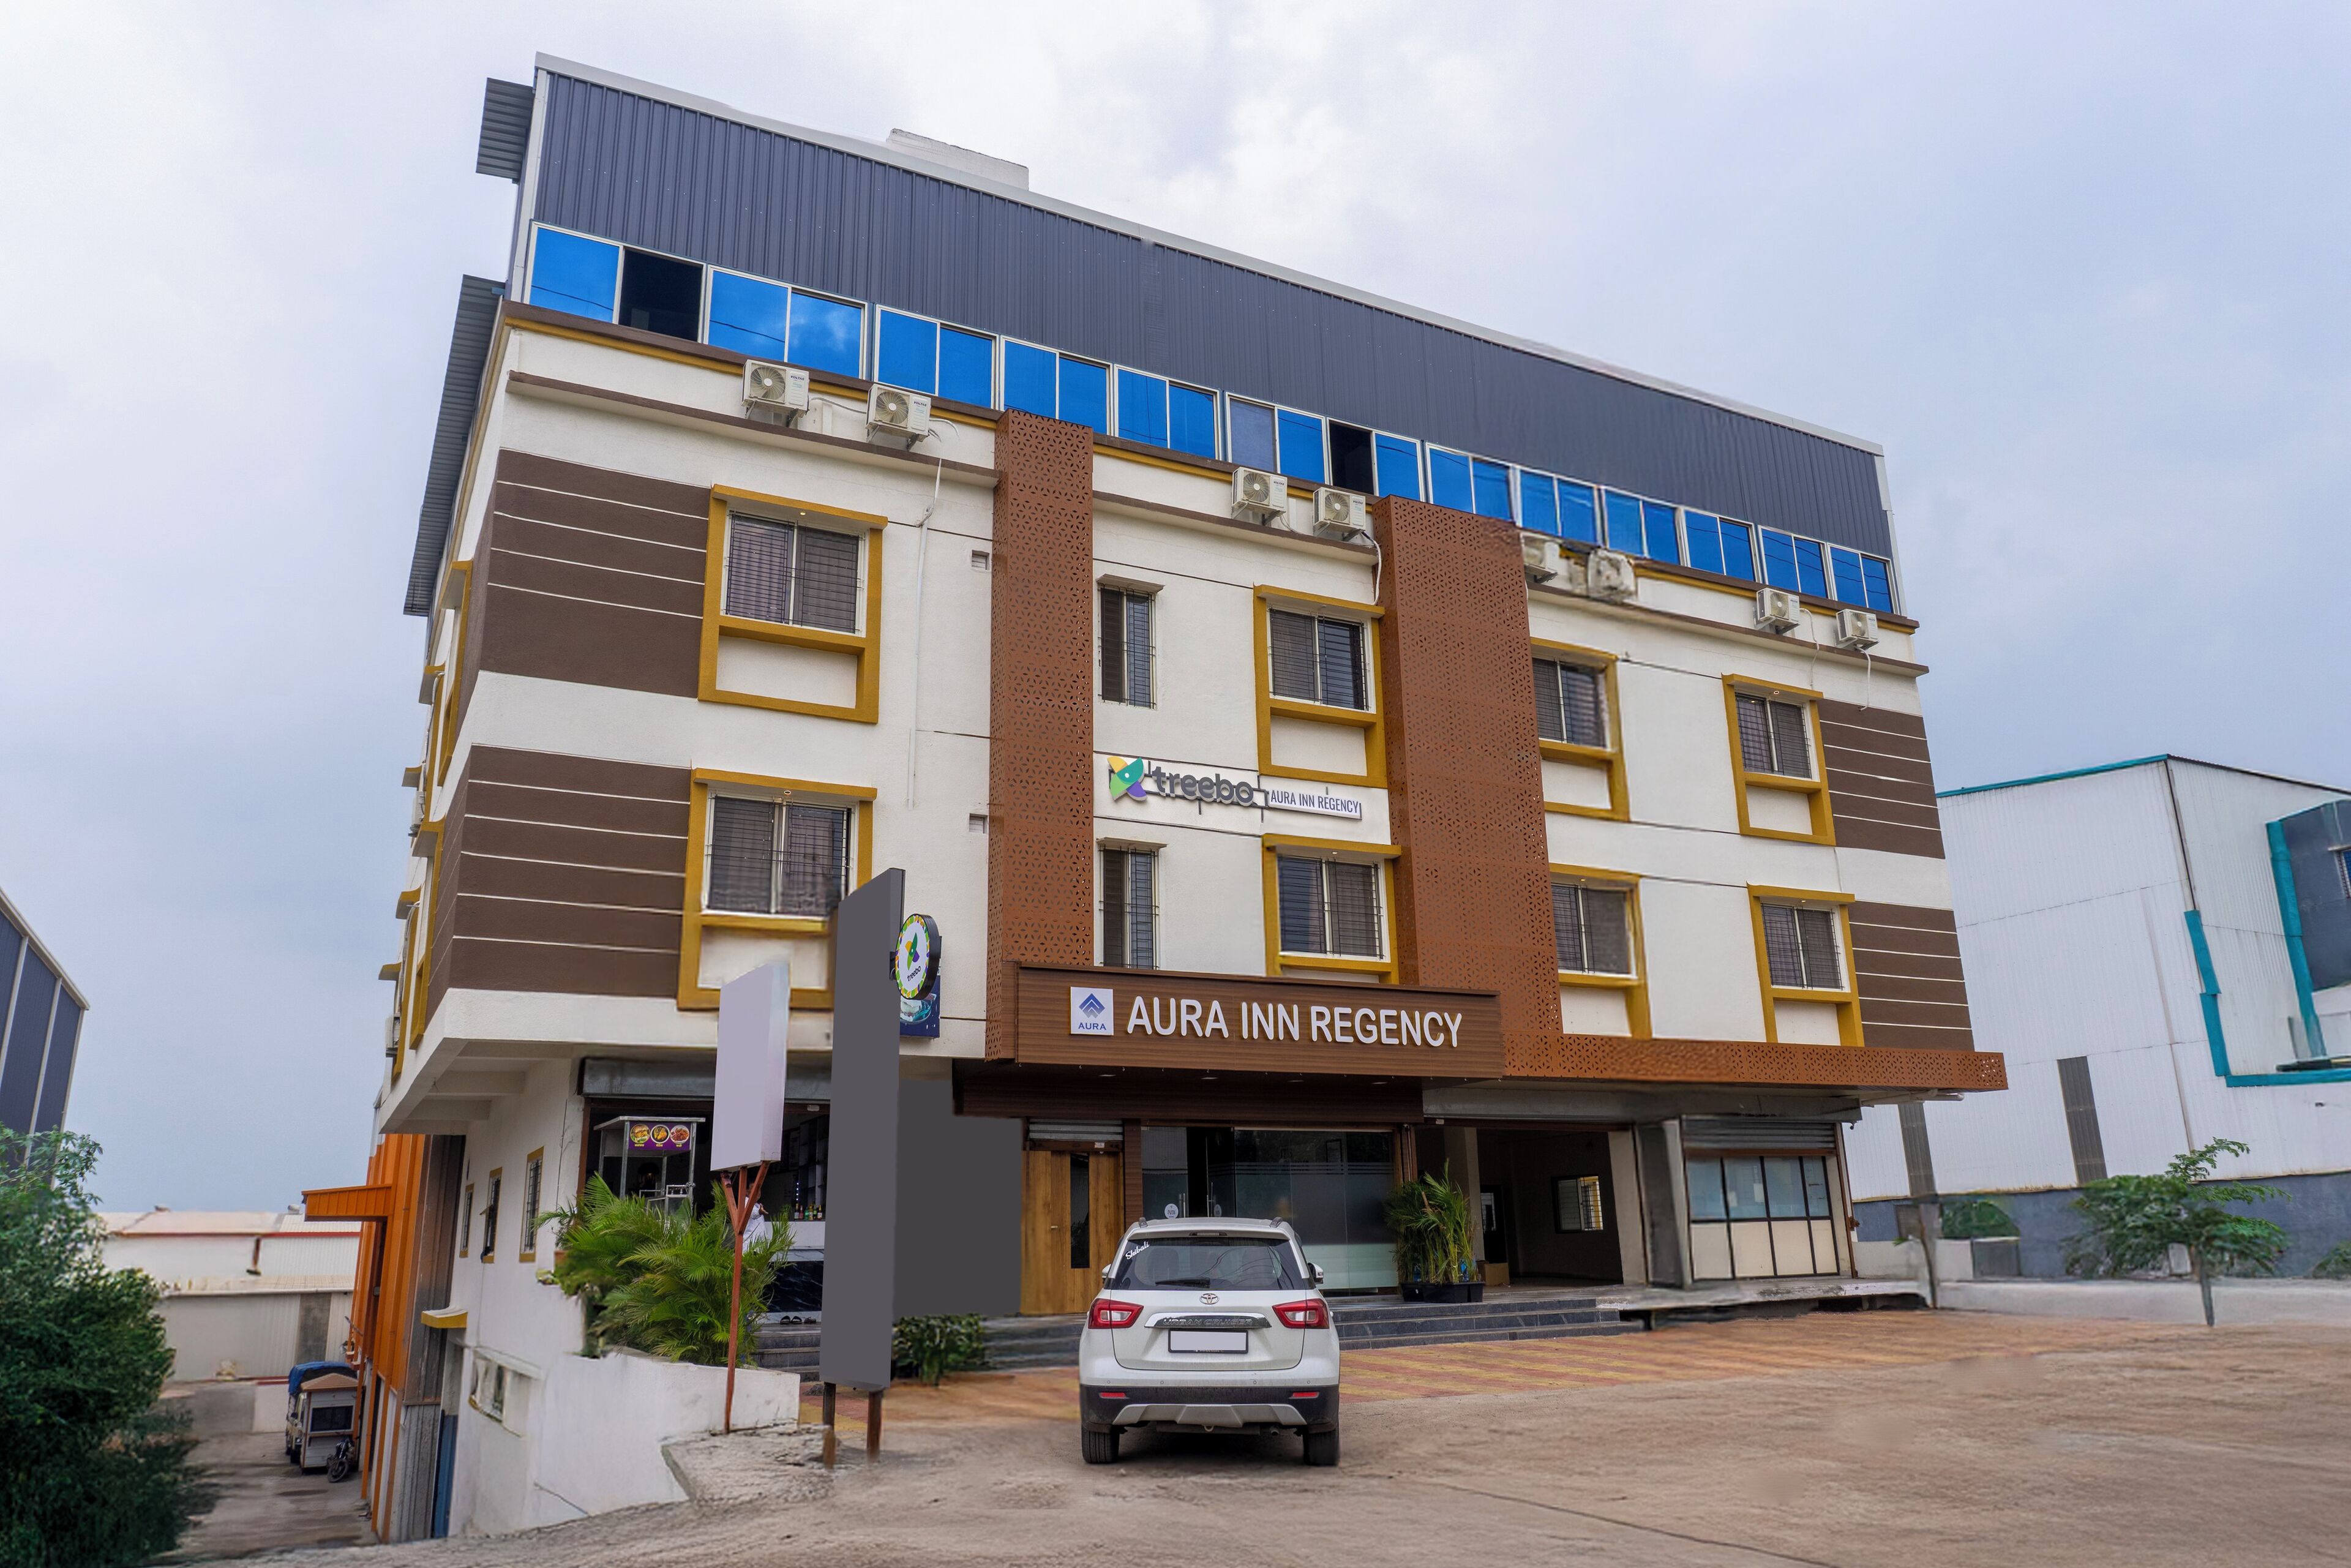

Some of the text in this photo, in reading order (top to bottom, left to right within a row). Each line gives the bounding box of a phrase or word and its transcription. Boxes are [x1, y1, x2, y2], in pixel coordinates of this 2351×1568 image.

[1152, 766, 1254, 806] treebo
[1270, 790, 1359, 814] AURA INN REGENCY
[907, 966, 921, 982] treebo
[1078, 1022, 1107, 1030] AURA
[1127, 995, 1463, 1049] AURA INN REGENCY
[1125, 1240, 1150, 1260] Shibali
